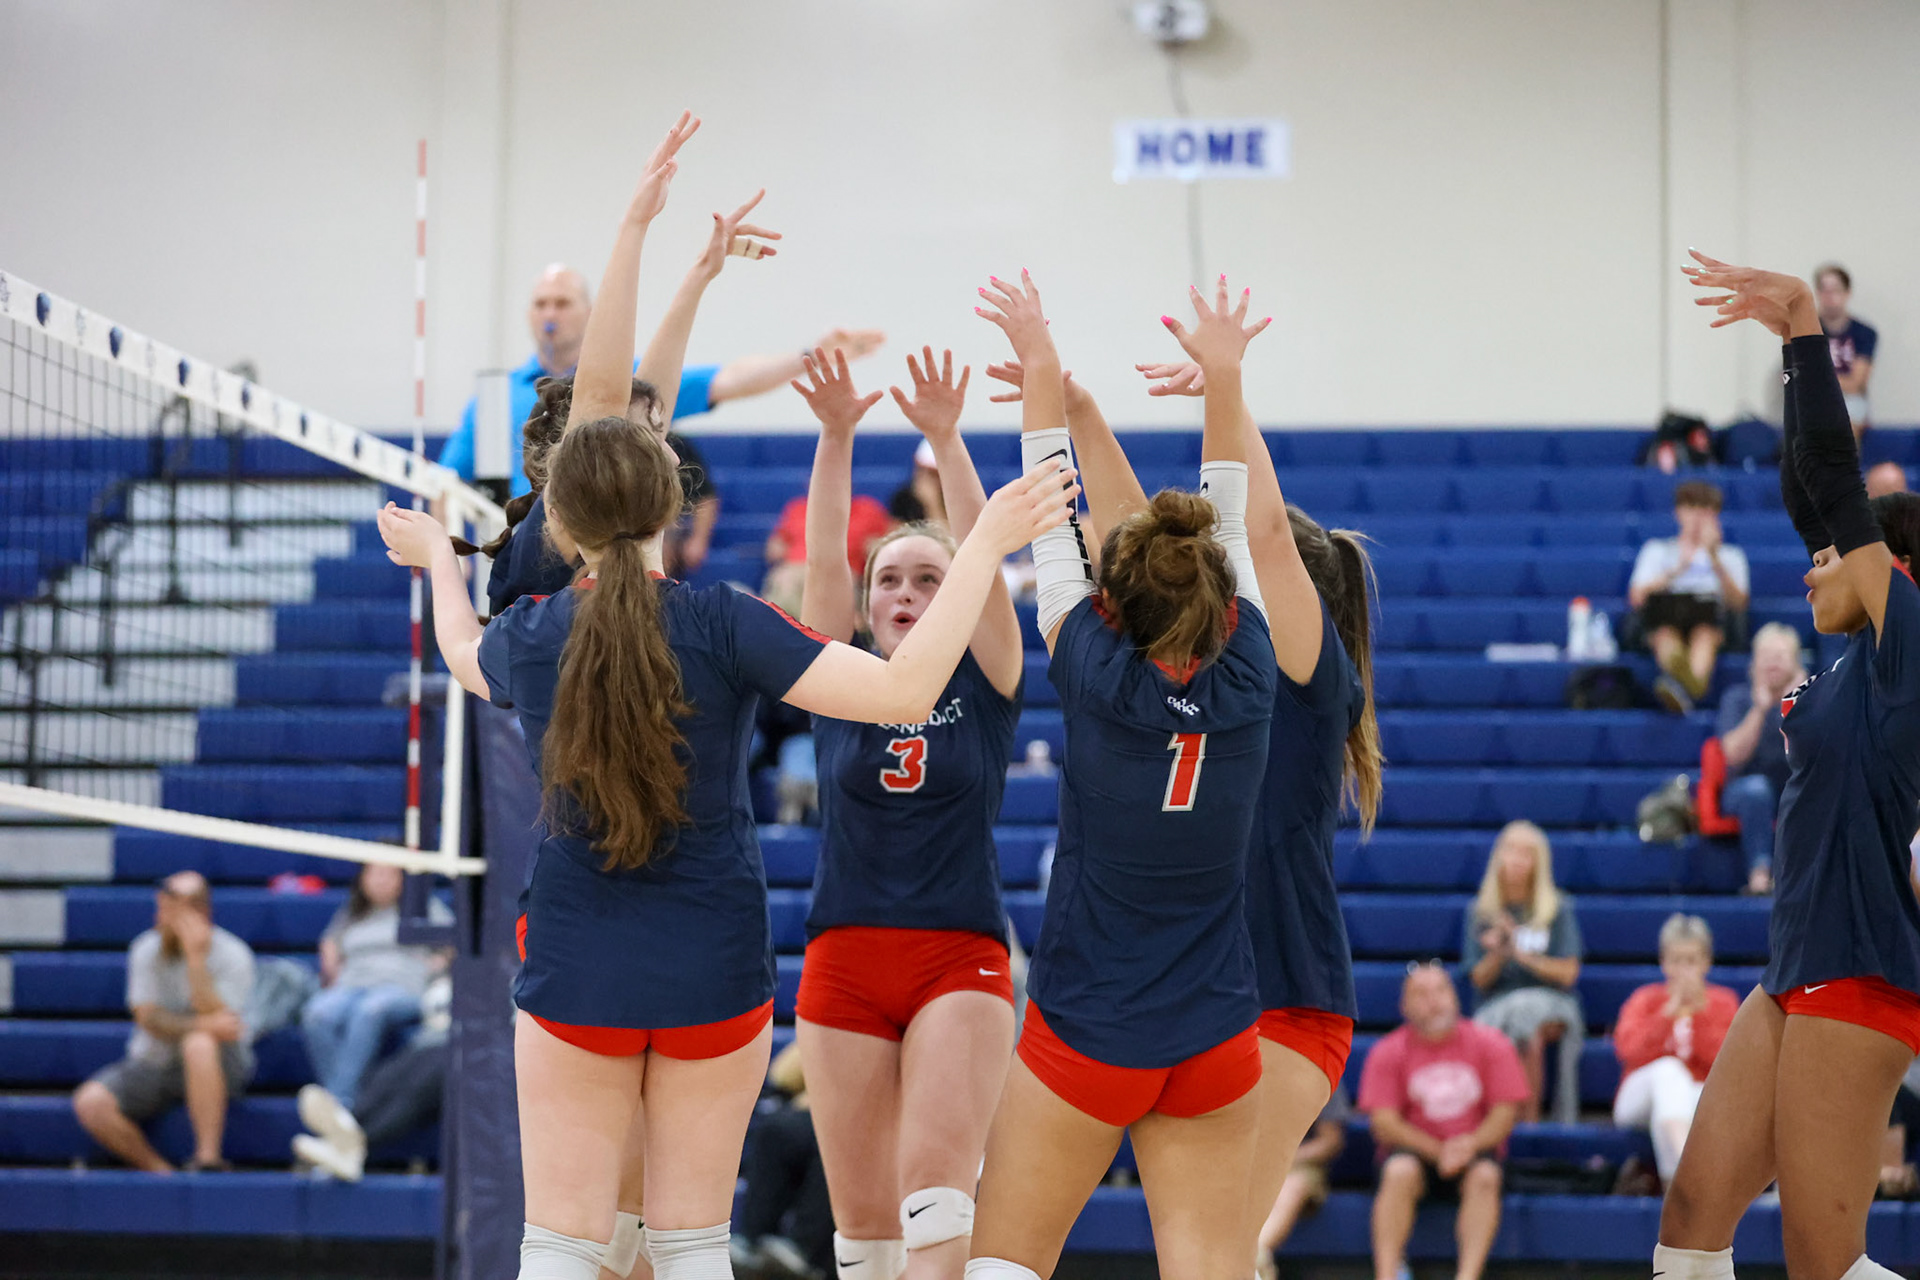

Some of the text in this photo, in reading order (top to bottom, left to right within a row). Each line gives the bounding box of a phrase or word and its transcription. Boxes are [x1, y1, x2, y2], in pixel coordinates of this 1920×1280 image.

[1136, 129, 1266, 167] HOME
[879, 735, 928, 793] 3
[1162, 732, 1207, 812] 1
